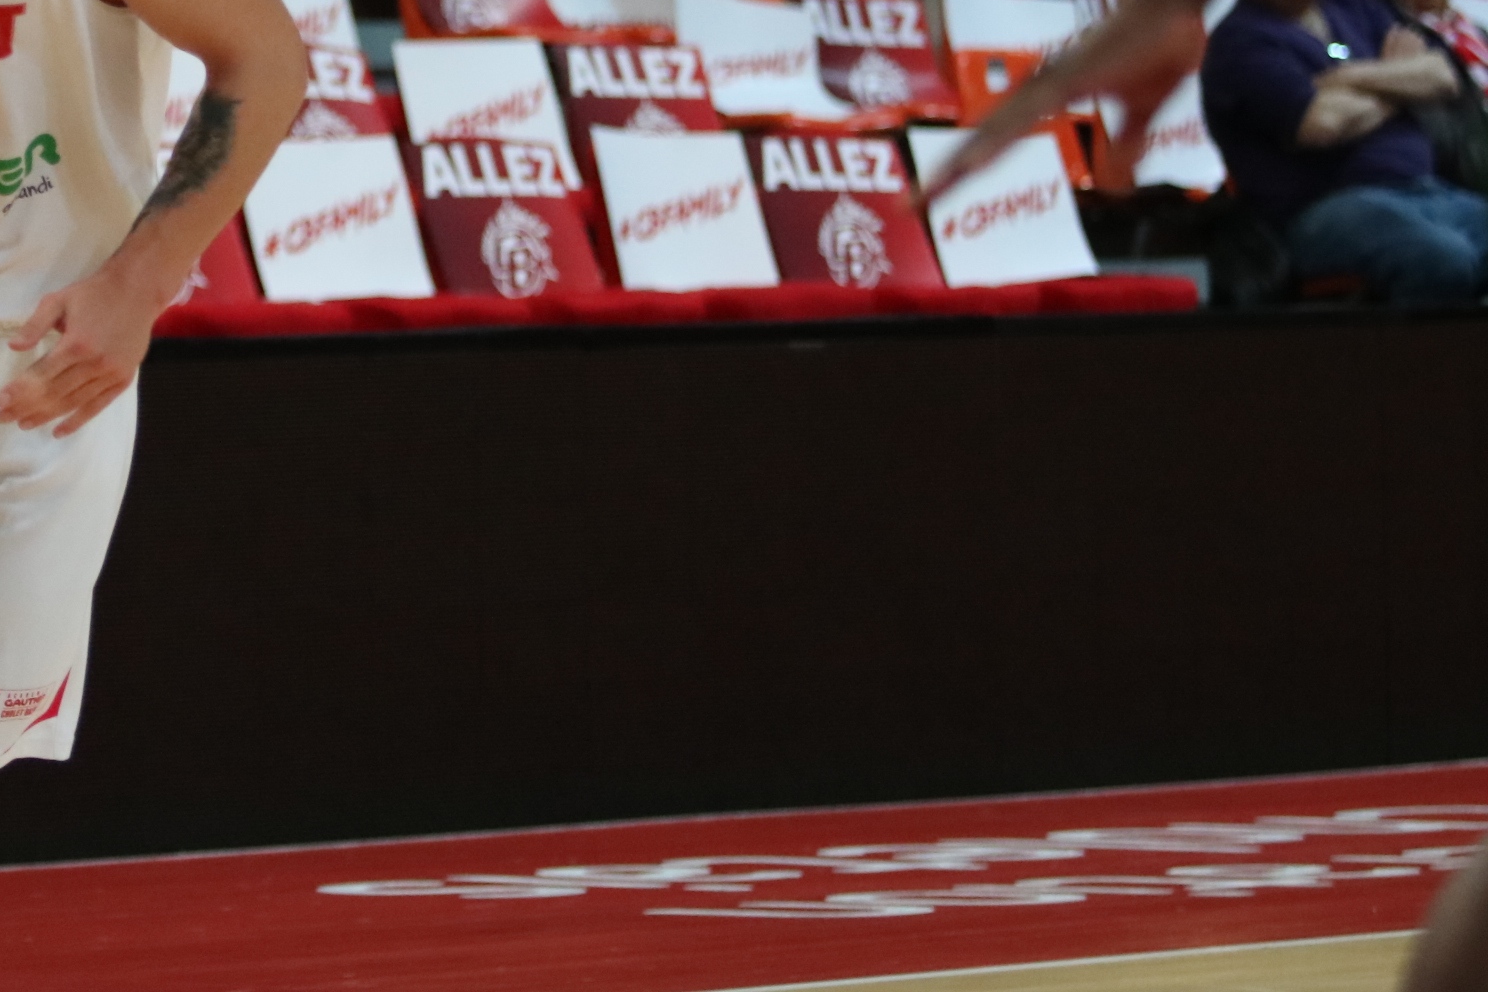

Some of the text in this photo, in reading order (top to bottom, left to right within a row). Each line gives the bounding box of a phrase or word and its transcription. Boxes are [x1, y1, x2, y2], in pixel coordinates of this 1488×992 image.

[568, 47, 705, 99] ALLEZ
[423, 145, 565, 198] ALLEZ
[765, 138, 903, 193] ALLEZ
